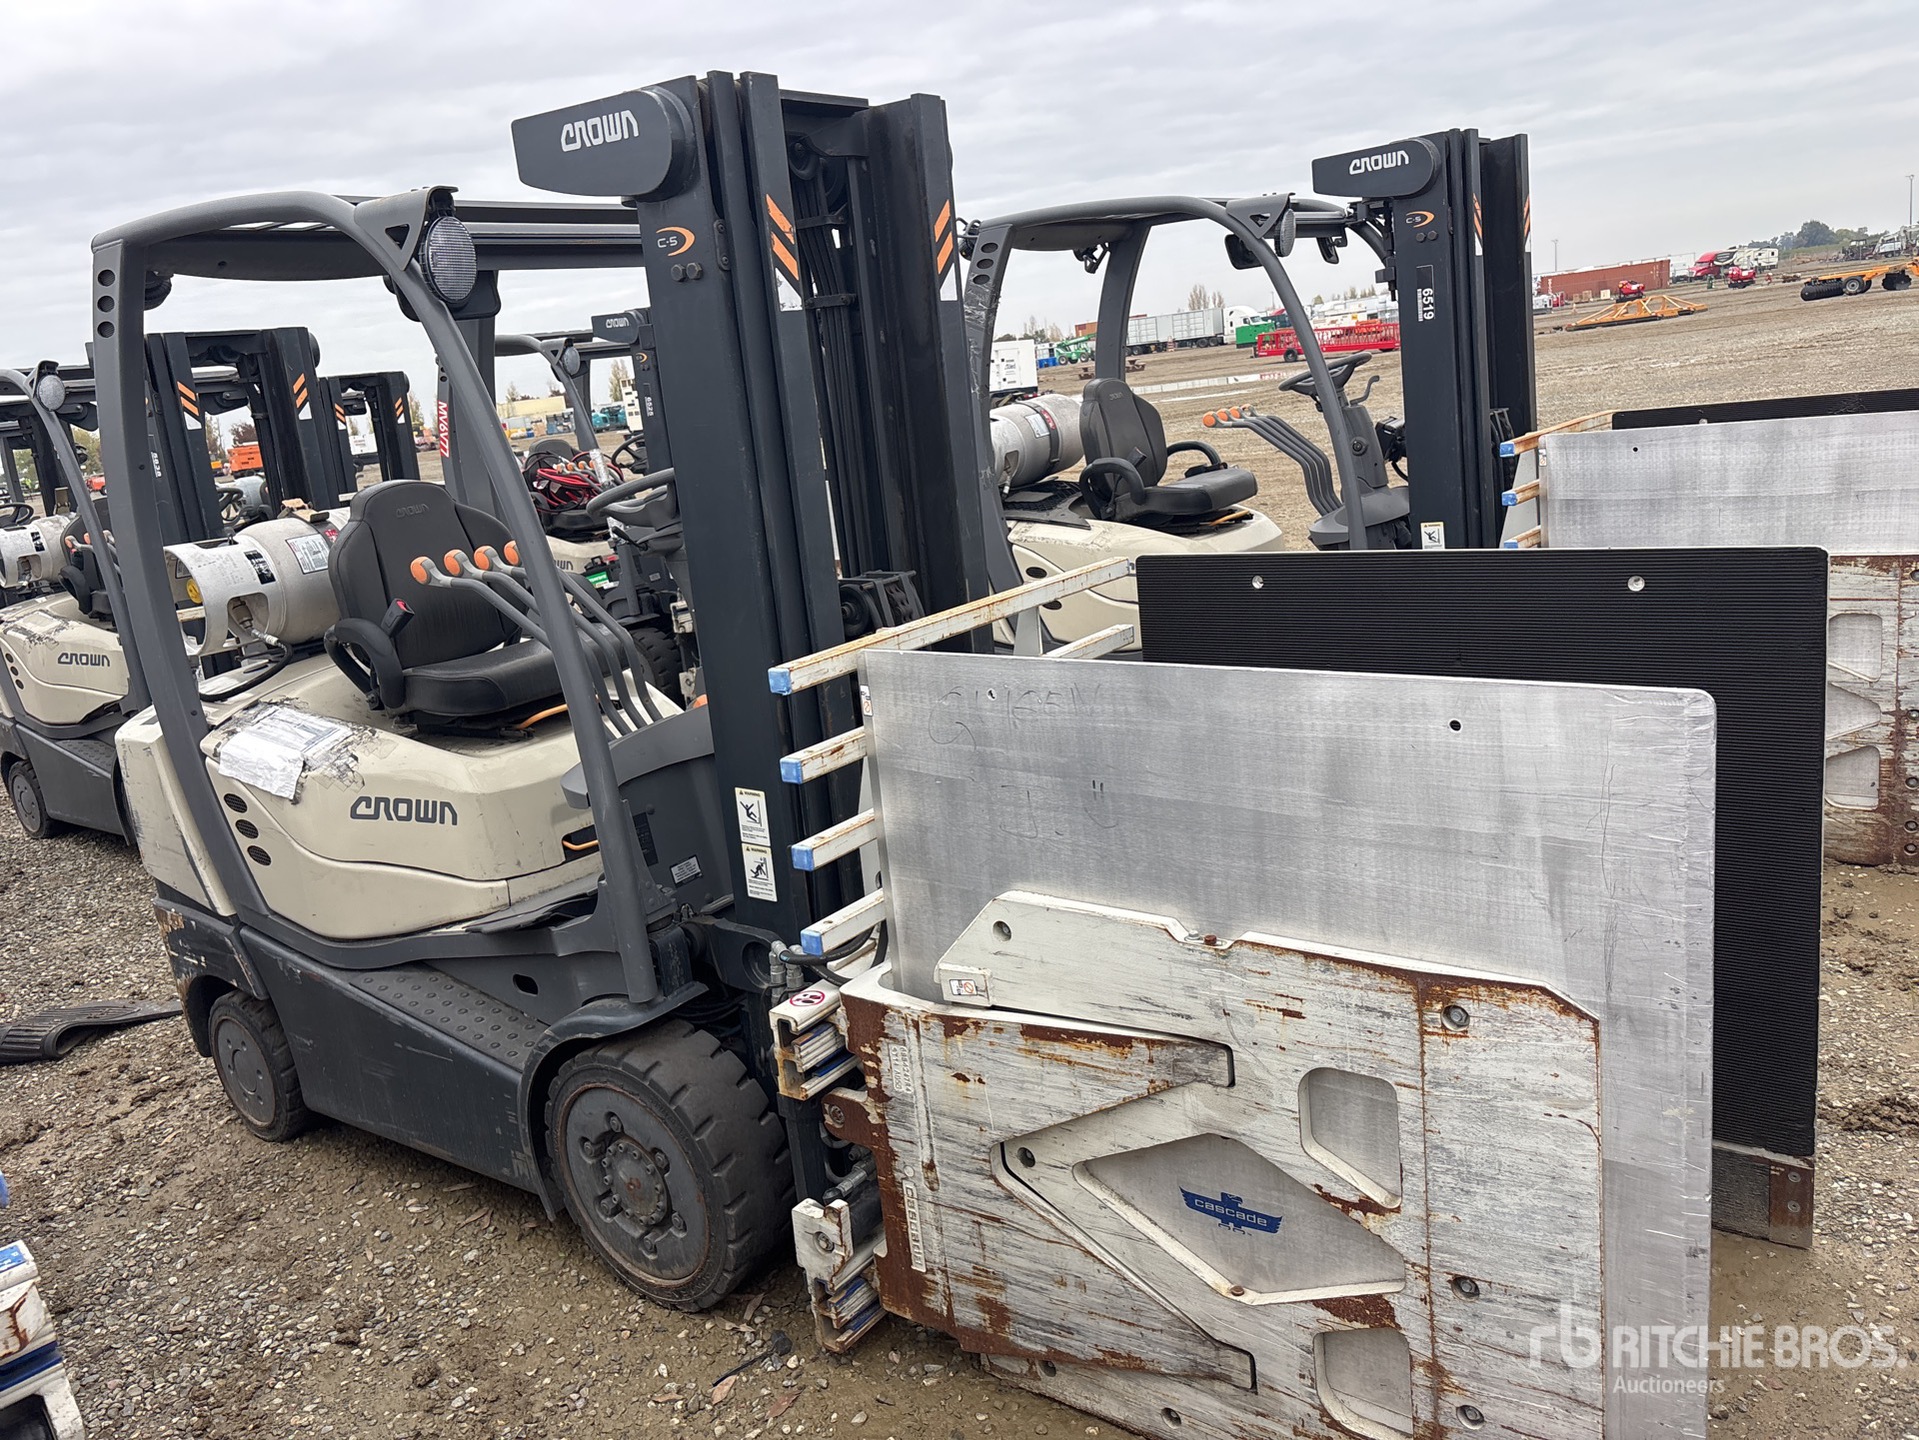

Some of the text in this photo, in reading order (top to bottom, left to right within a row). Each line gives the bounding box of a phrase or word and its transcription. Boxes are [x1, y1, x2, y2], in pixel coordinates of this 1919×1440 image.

[561, 110, 639, 152] CROWN
[1349, 150, 1409, 175] CROWN
[1422, 288, 1434, 320] 6519
[438, 401, 449, 458] MV6V77
[58, 652, 110, 667] CROWN
[350, 796, 458, 826] CROWN
[1194, 1198, 1267, 1227] cascade
